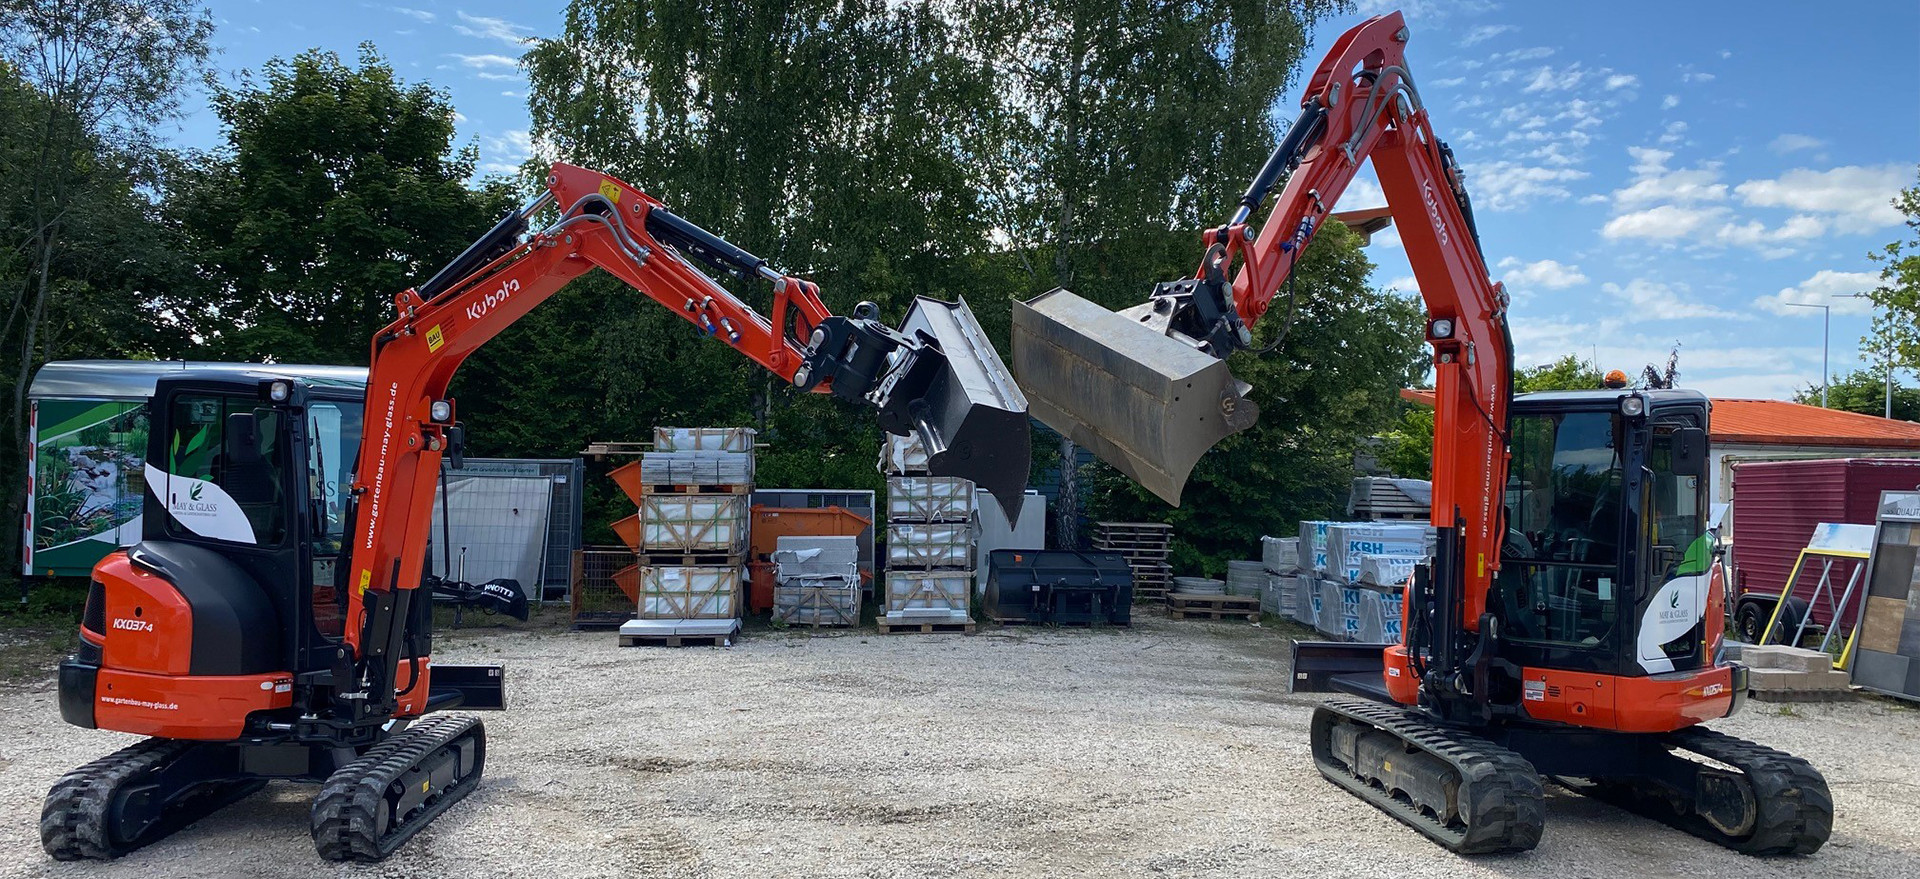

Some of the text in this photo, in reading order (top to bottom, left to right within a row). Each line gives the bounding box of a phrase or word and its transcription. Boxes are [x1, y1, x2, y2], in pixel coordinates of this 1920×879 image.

[1423, 178, 1448, 246] Kubota
[466, 279, 520, 320] Kubota
[428, 331, 441, 344] BAU
[366, 381, 398, 549] www.gartenbau-may-glass.de
[1482, 384, 1496, 539] www.grtenbau-may-glass.de
[196, 503, 217, 512] GLASS
[1896, 507, 1920, 516] QUALIT
[1350, 541, 1384, 554] KBH
[113, 618, 153, 633] KX037-4
[101, 696, 179, 710] www.gartenbau-may-glass.de
